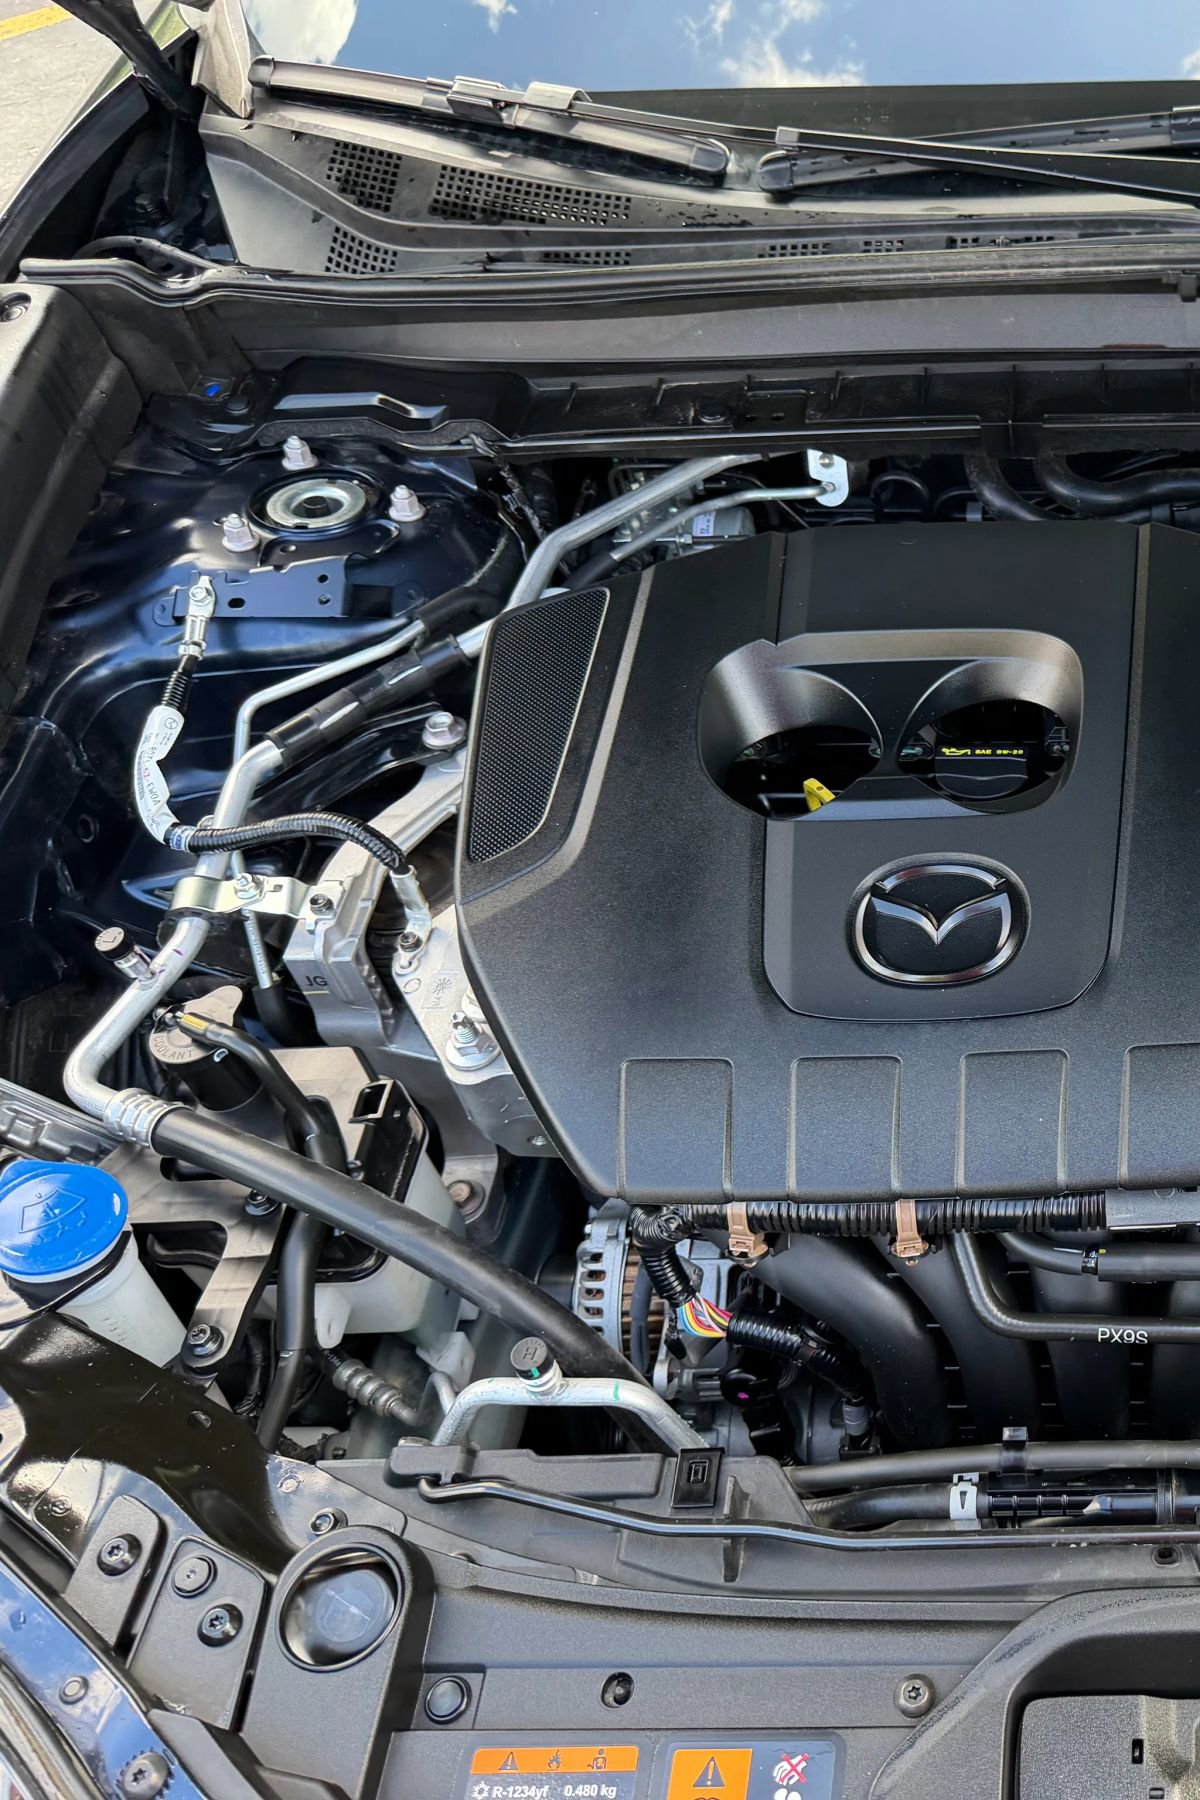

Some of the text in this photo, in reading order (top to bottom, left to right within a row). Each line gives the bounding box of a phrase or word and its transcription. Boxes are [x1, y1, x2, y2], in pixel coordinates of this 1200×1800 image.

[305, 975, 328, 987] JG
[153, 1035, 194, 1060] COOLANT
[1097, 1327, 1148, 1345] PX9S
[492, 1785, 617, 1799] R-1234yf 0.480 kg
